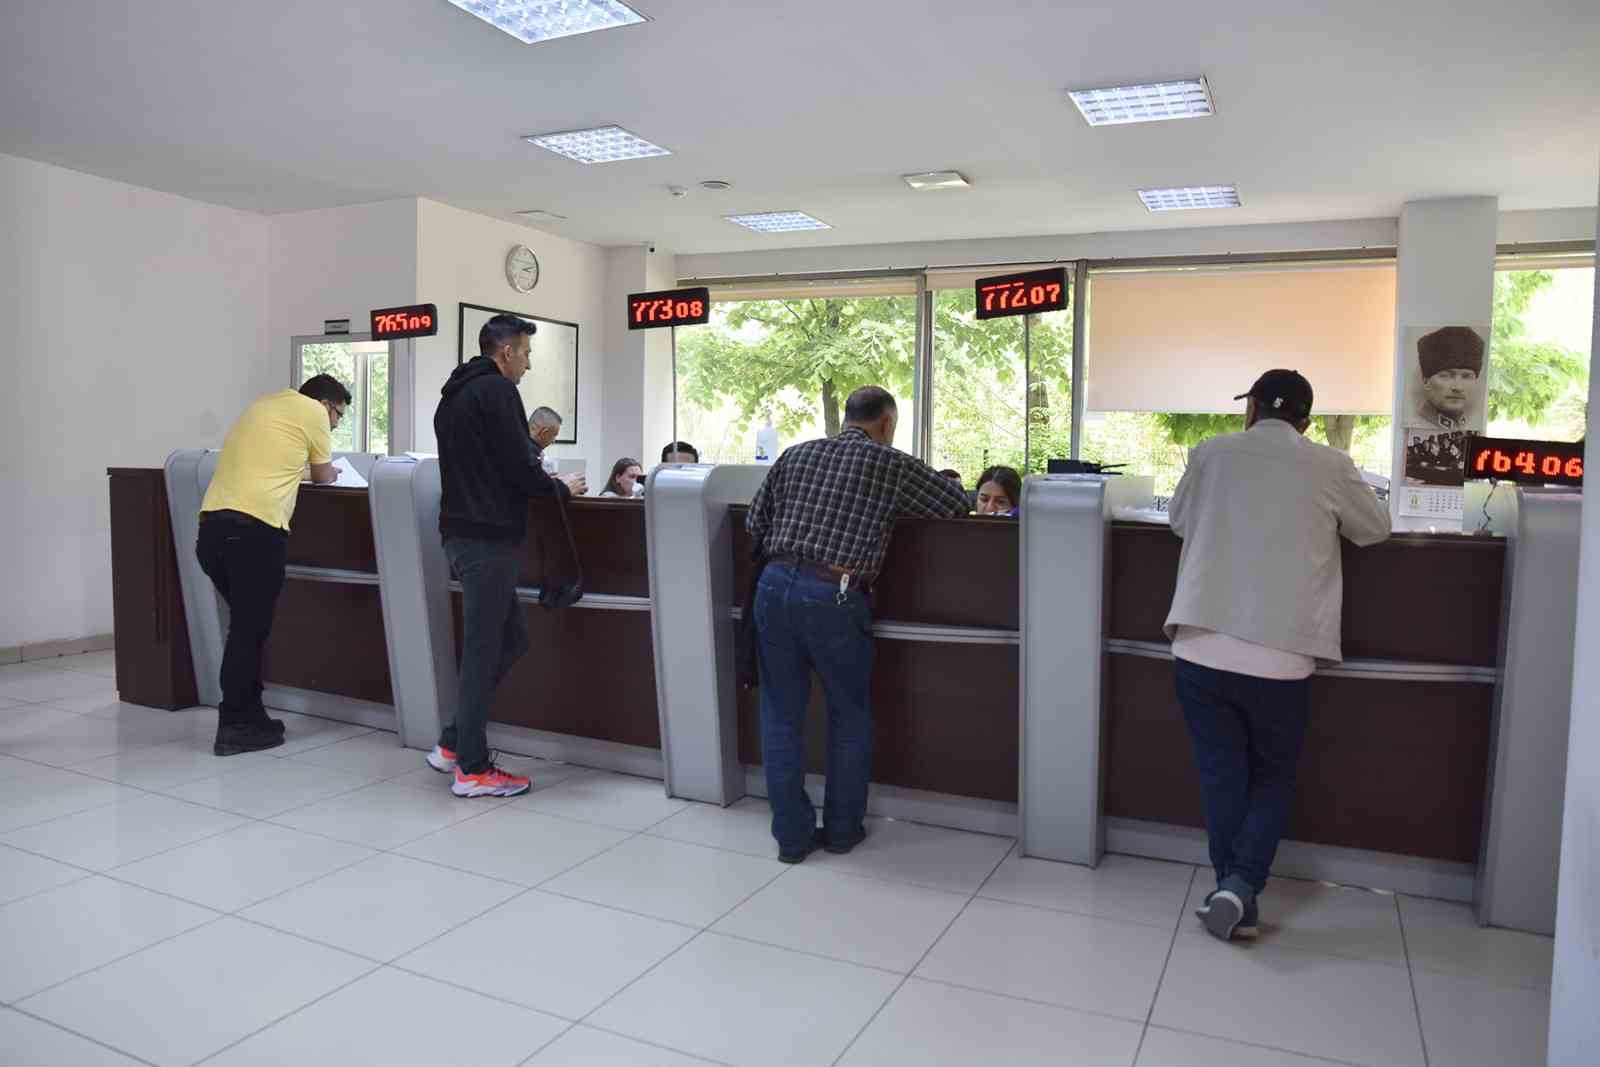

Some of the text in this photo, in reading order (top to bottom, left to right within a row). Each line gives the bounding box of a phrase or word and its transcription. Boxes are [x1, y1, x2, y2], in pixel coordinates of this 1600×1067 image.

[982, 282, 1060, 311] 772 07
[632, 299, 703, 322] 773 08
[1542, 456, 1583, 477] 06
